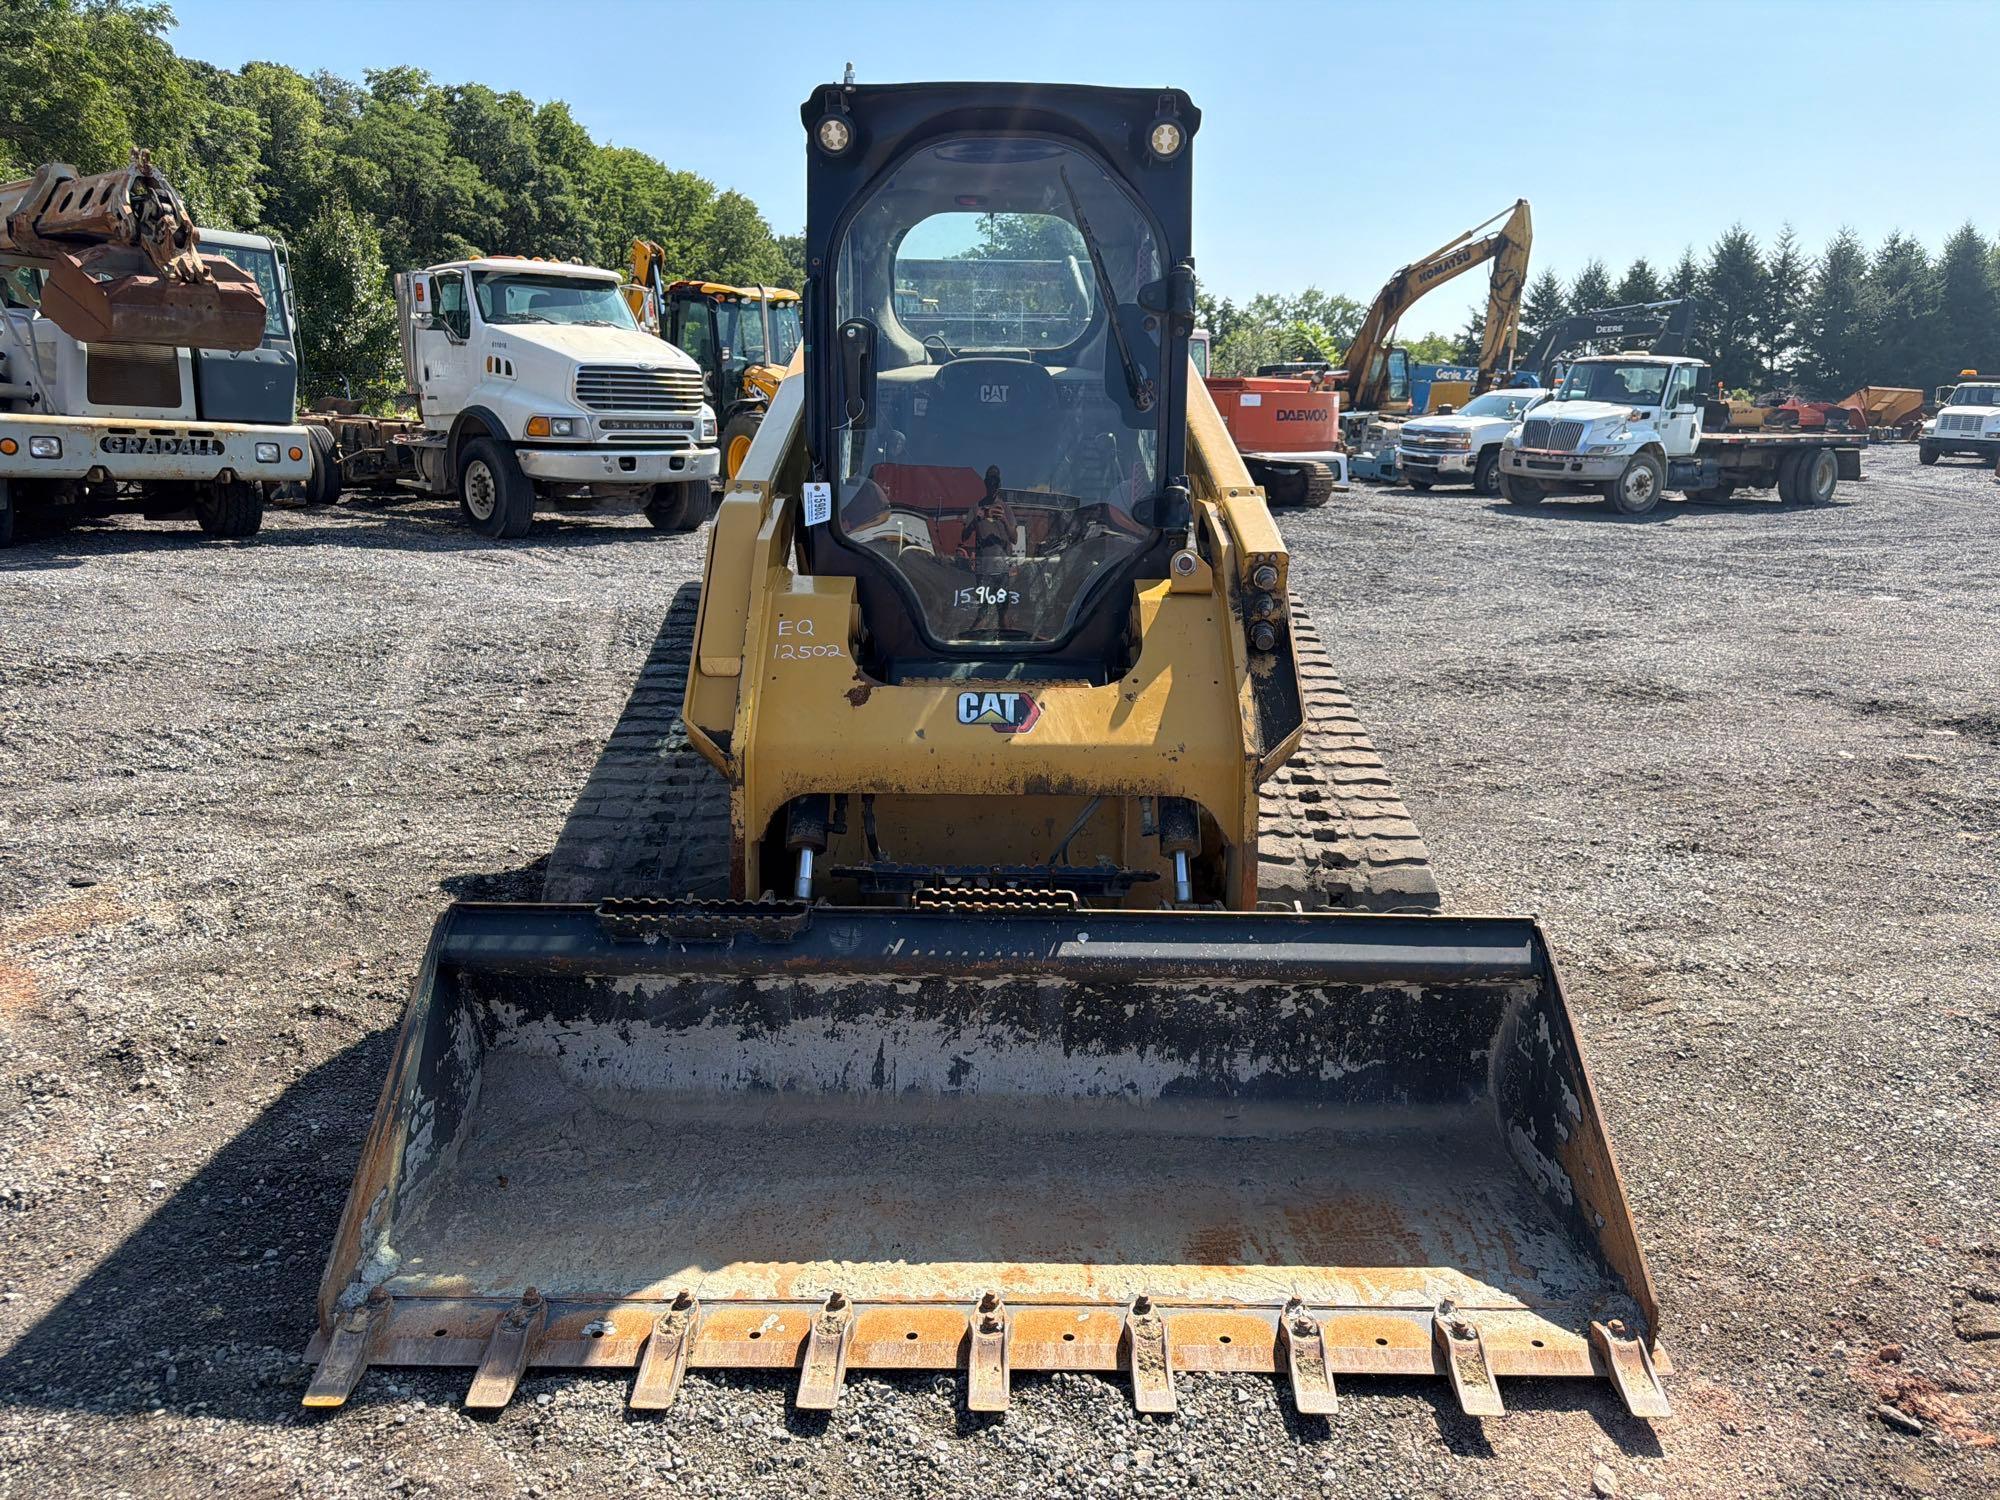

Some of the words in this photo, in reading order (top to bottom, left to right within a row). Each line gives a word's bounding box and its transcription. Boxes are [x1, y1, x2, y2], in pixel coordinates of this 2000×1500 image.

[1418, 250, 1472, 284] KOMATSU
[1595, 325, 1624, 334] DEERE
[1435, 367, 1462, 380] Genie
[980, 384, 1009, 403] CAT
[1276, 409, 1328, 422] DAEWOO
[611, 421, 684, 430] STERLING
[105, 436, 219, 456] GRADALL
[814, 493, 827, 520] 159683
[953, 586, 1020, 607] 159683
[778, 619, 815, 637] EQ
[773, 643, 848, 661] 12502
[958, 691, 1021, 724] CAT
